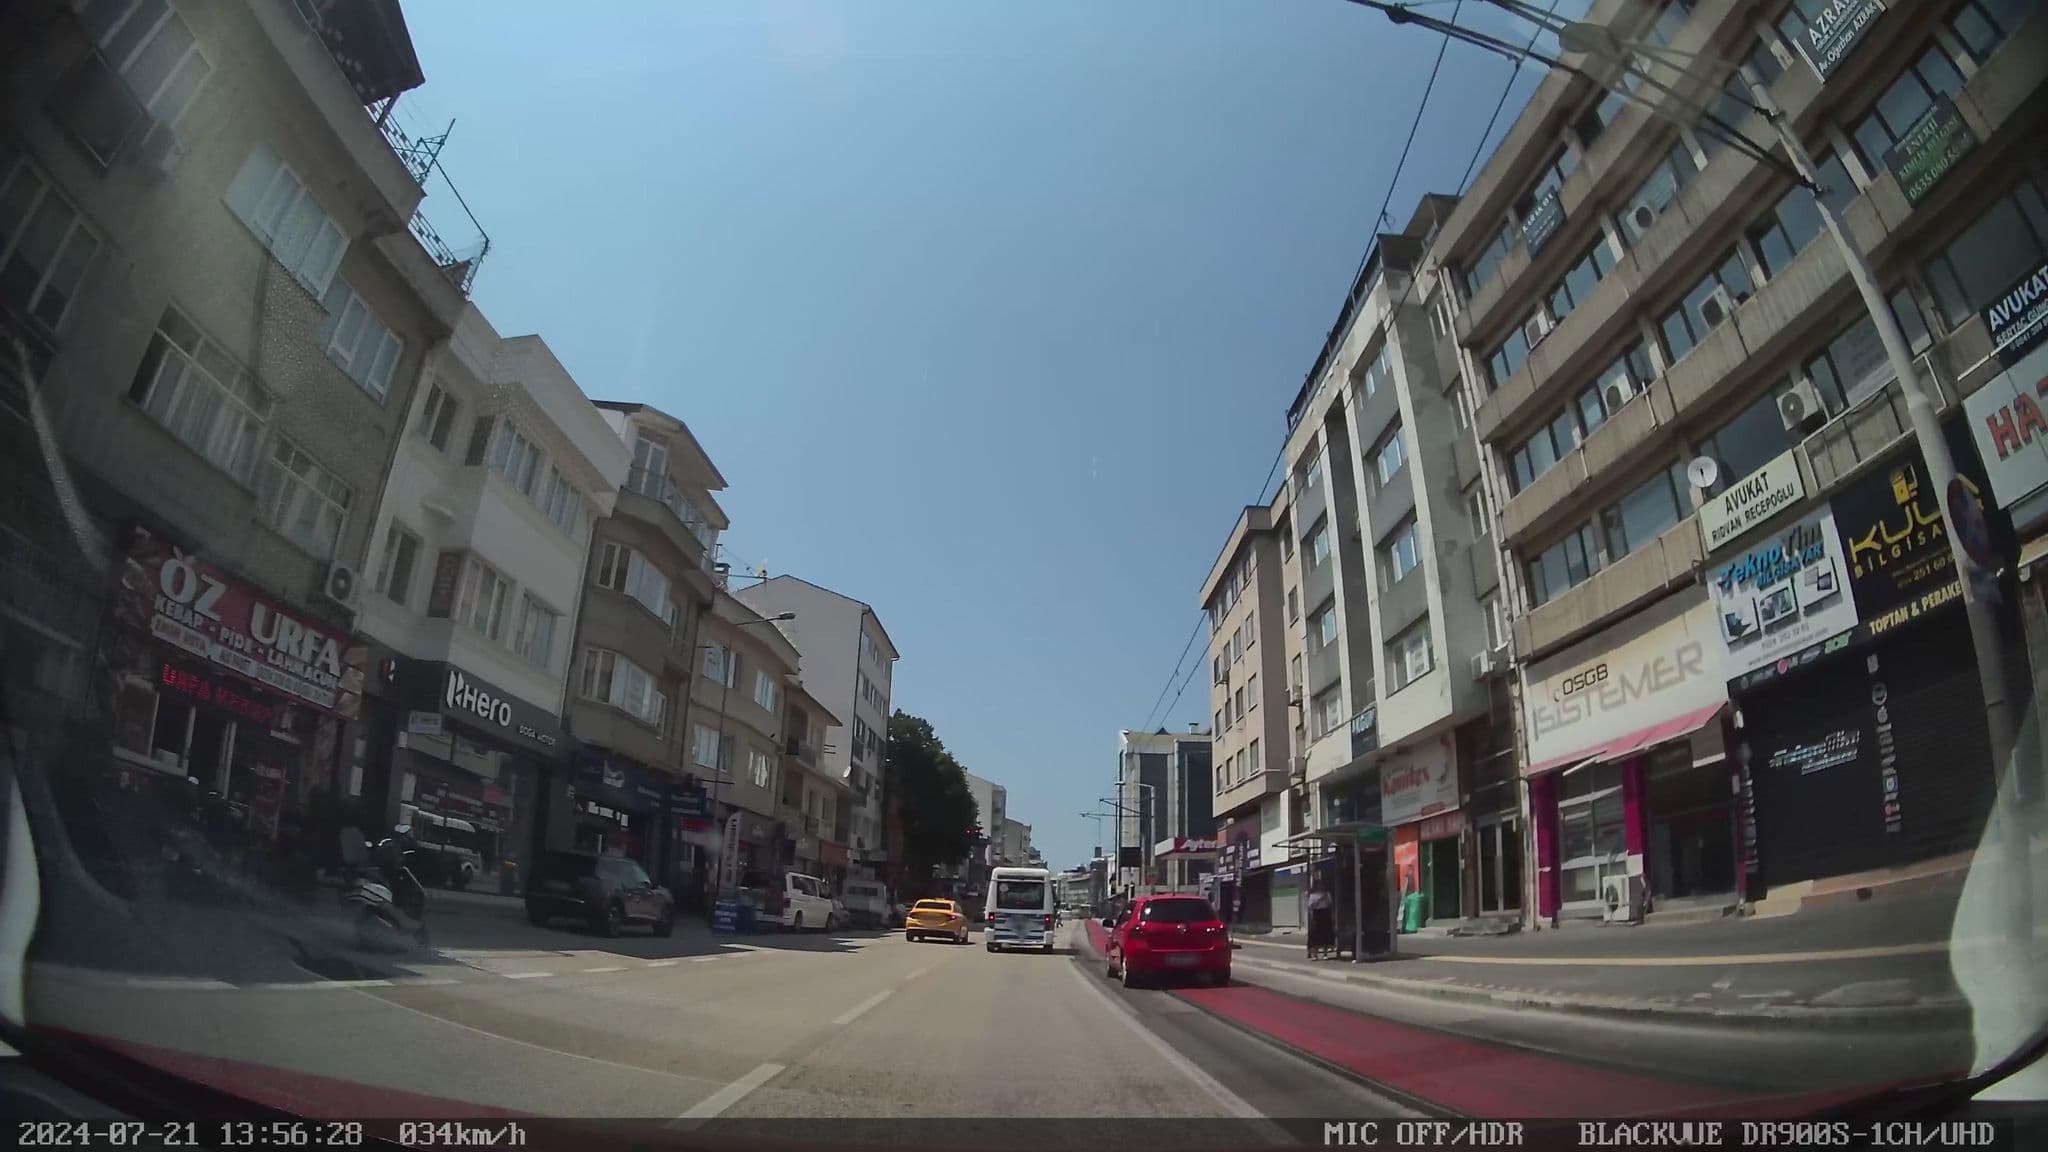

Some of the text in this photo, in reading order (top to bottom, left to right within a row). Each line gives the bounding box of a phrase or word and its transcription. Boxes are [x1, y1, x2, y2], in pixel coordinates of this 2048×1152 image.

[1808, 0, 1861, 46] AZRA
[1986, 376, 2048, 462] HA
[1725, 471, 1769, 515] AVUKAT
[1712, 514, 1742, 544] RIDVAN
[159, 545, 227, 623] ÖZ
[251, 602, 341, 678] URFA
[1869, 611, 1909, 636] TOPTAN
[1562, 663, 1609, 696] OSGB
